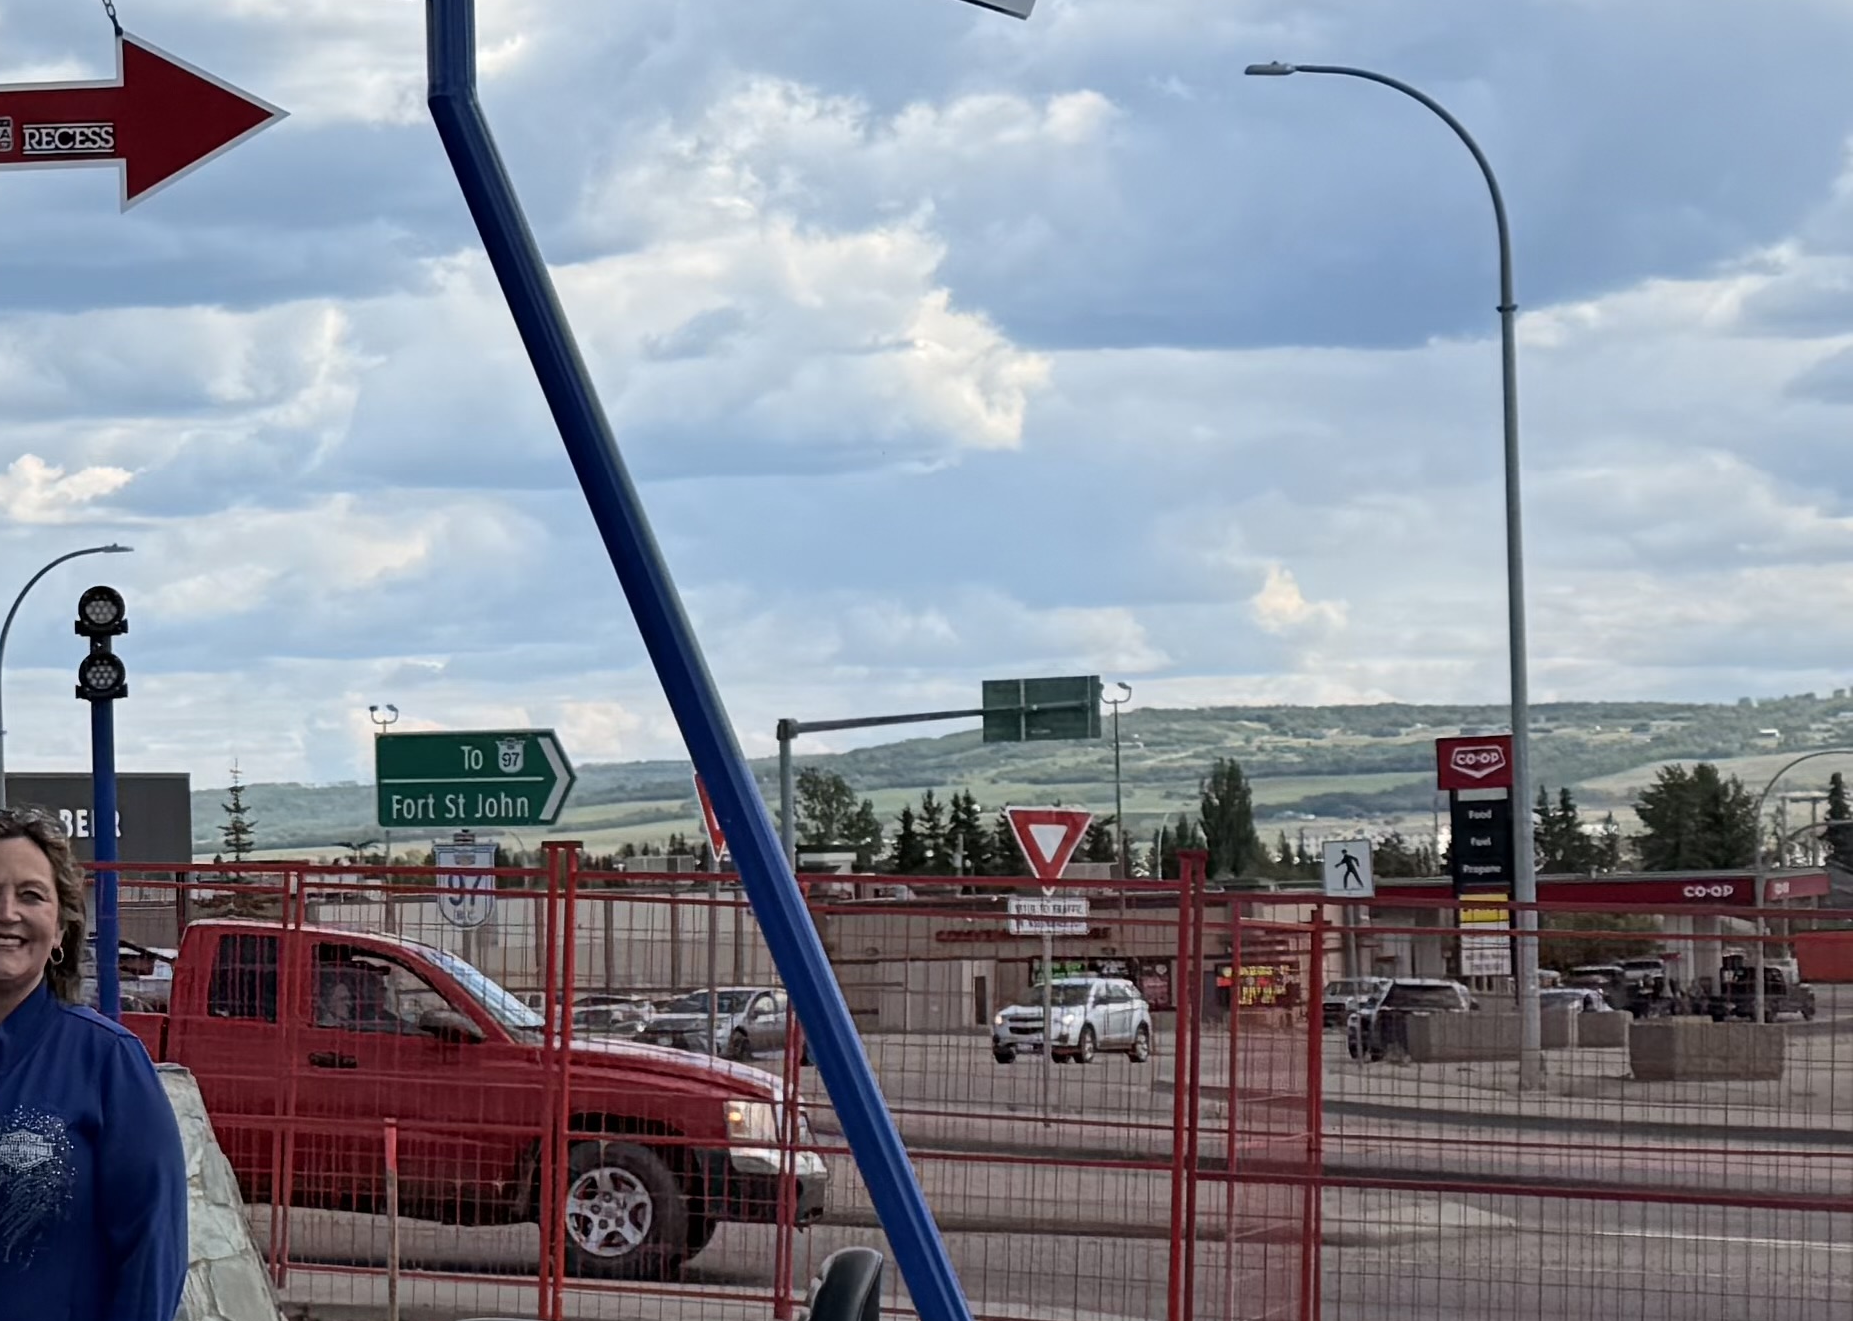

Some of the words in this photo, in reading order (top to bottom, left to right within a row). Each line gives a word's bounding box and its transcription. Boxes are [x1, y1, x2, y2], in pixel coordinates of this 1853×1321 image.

[22, 127, 114, 150] RECESS
[460, 745, 484, 770] To
[501, 751, 521, 768] 97
[1455, 752, 1500, 766] CO-OP
[391, 793, 436, 820] Fort
[445, 793, 466, 819] St
[473, 791, 529, 819] John
[1467, 808, 1493, 820] Food
[1469, 835, 1492, 847] Fuel
[1462, 863, 1502, 876] Propane
[1682, 884, 1735, 898] CO-OP
